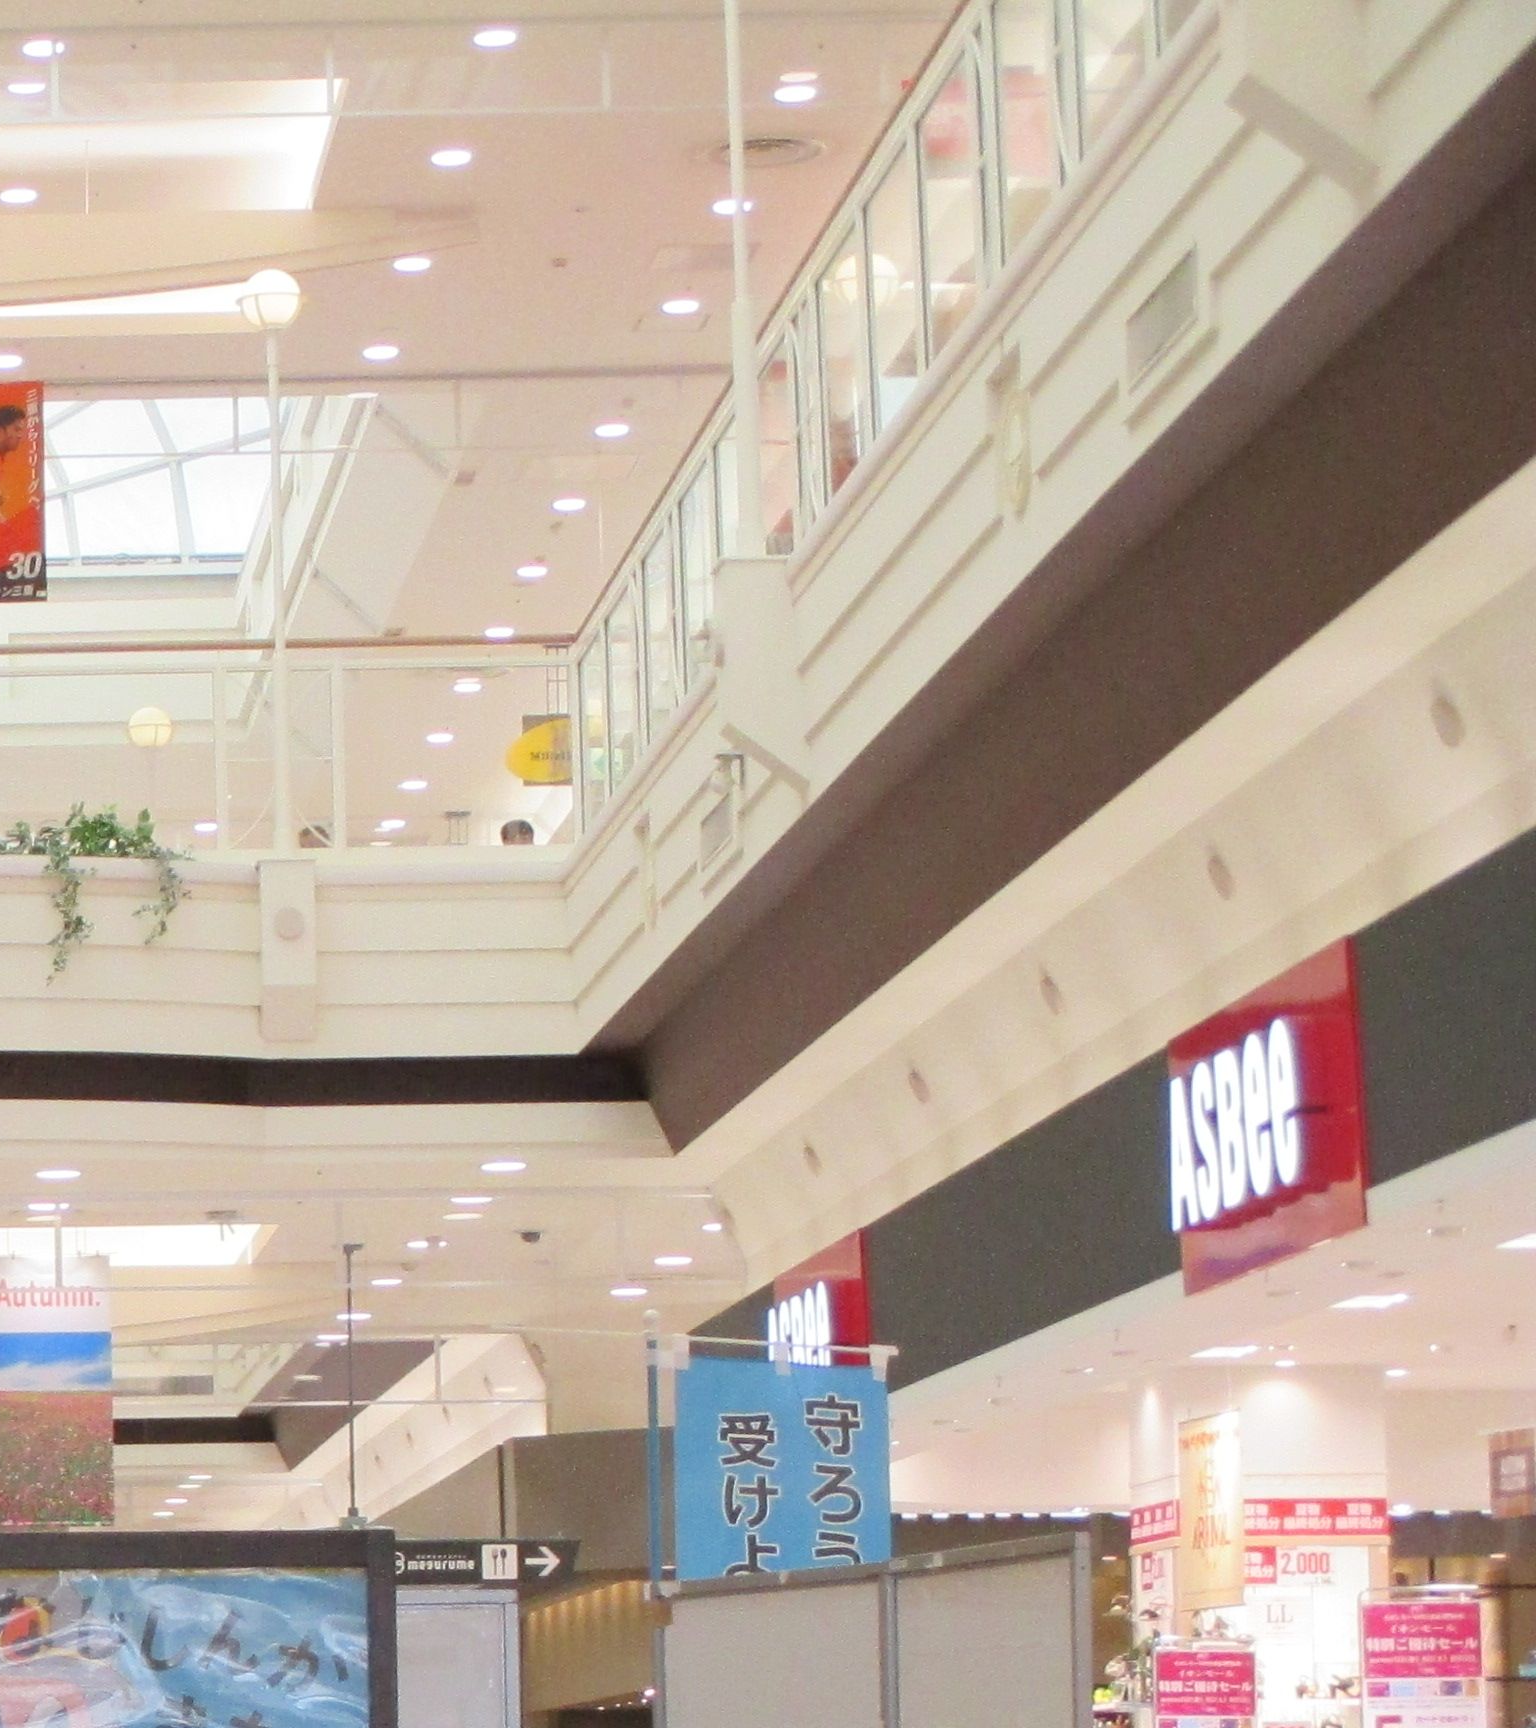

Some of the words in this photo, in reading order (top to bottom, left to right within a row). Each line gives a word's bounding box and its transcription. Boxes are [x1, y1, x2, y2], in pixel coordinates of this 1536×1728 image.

[7, 551, 43, 580] 30
[1170, 1018, 1302, 1232] ASBee
[1280, 1552, 1331, 1576] 2,000
